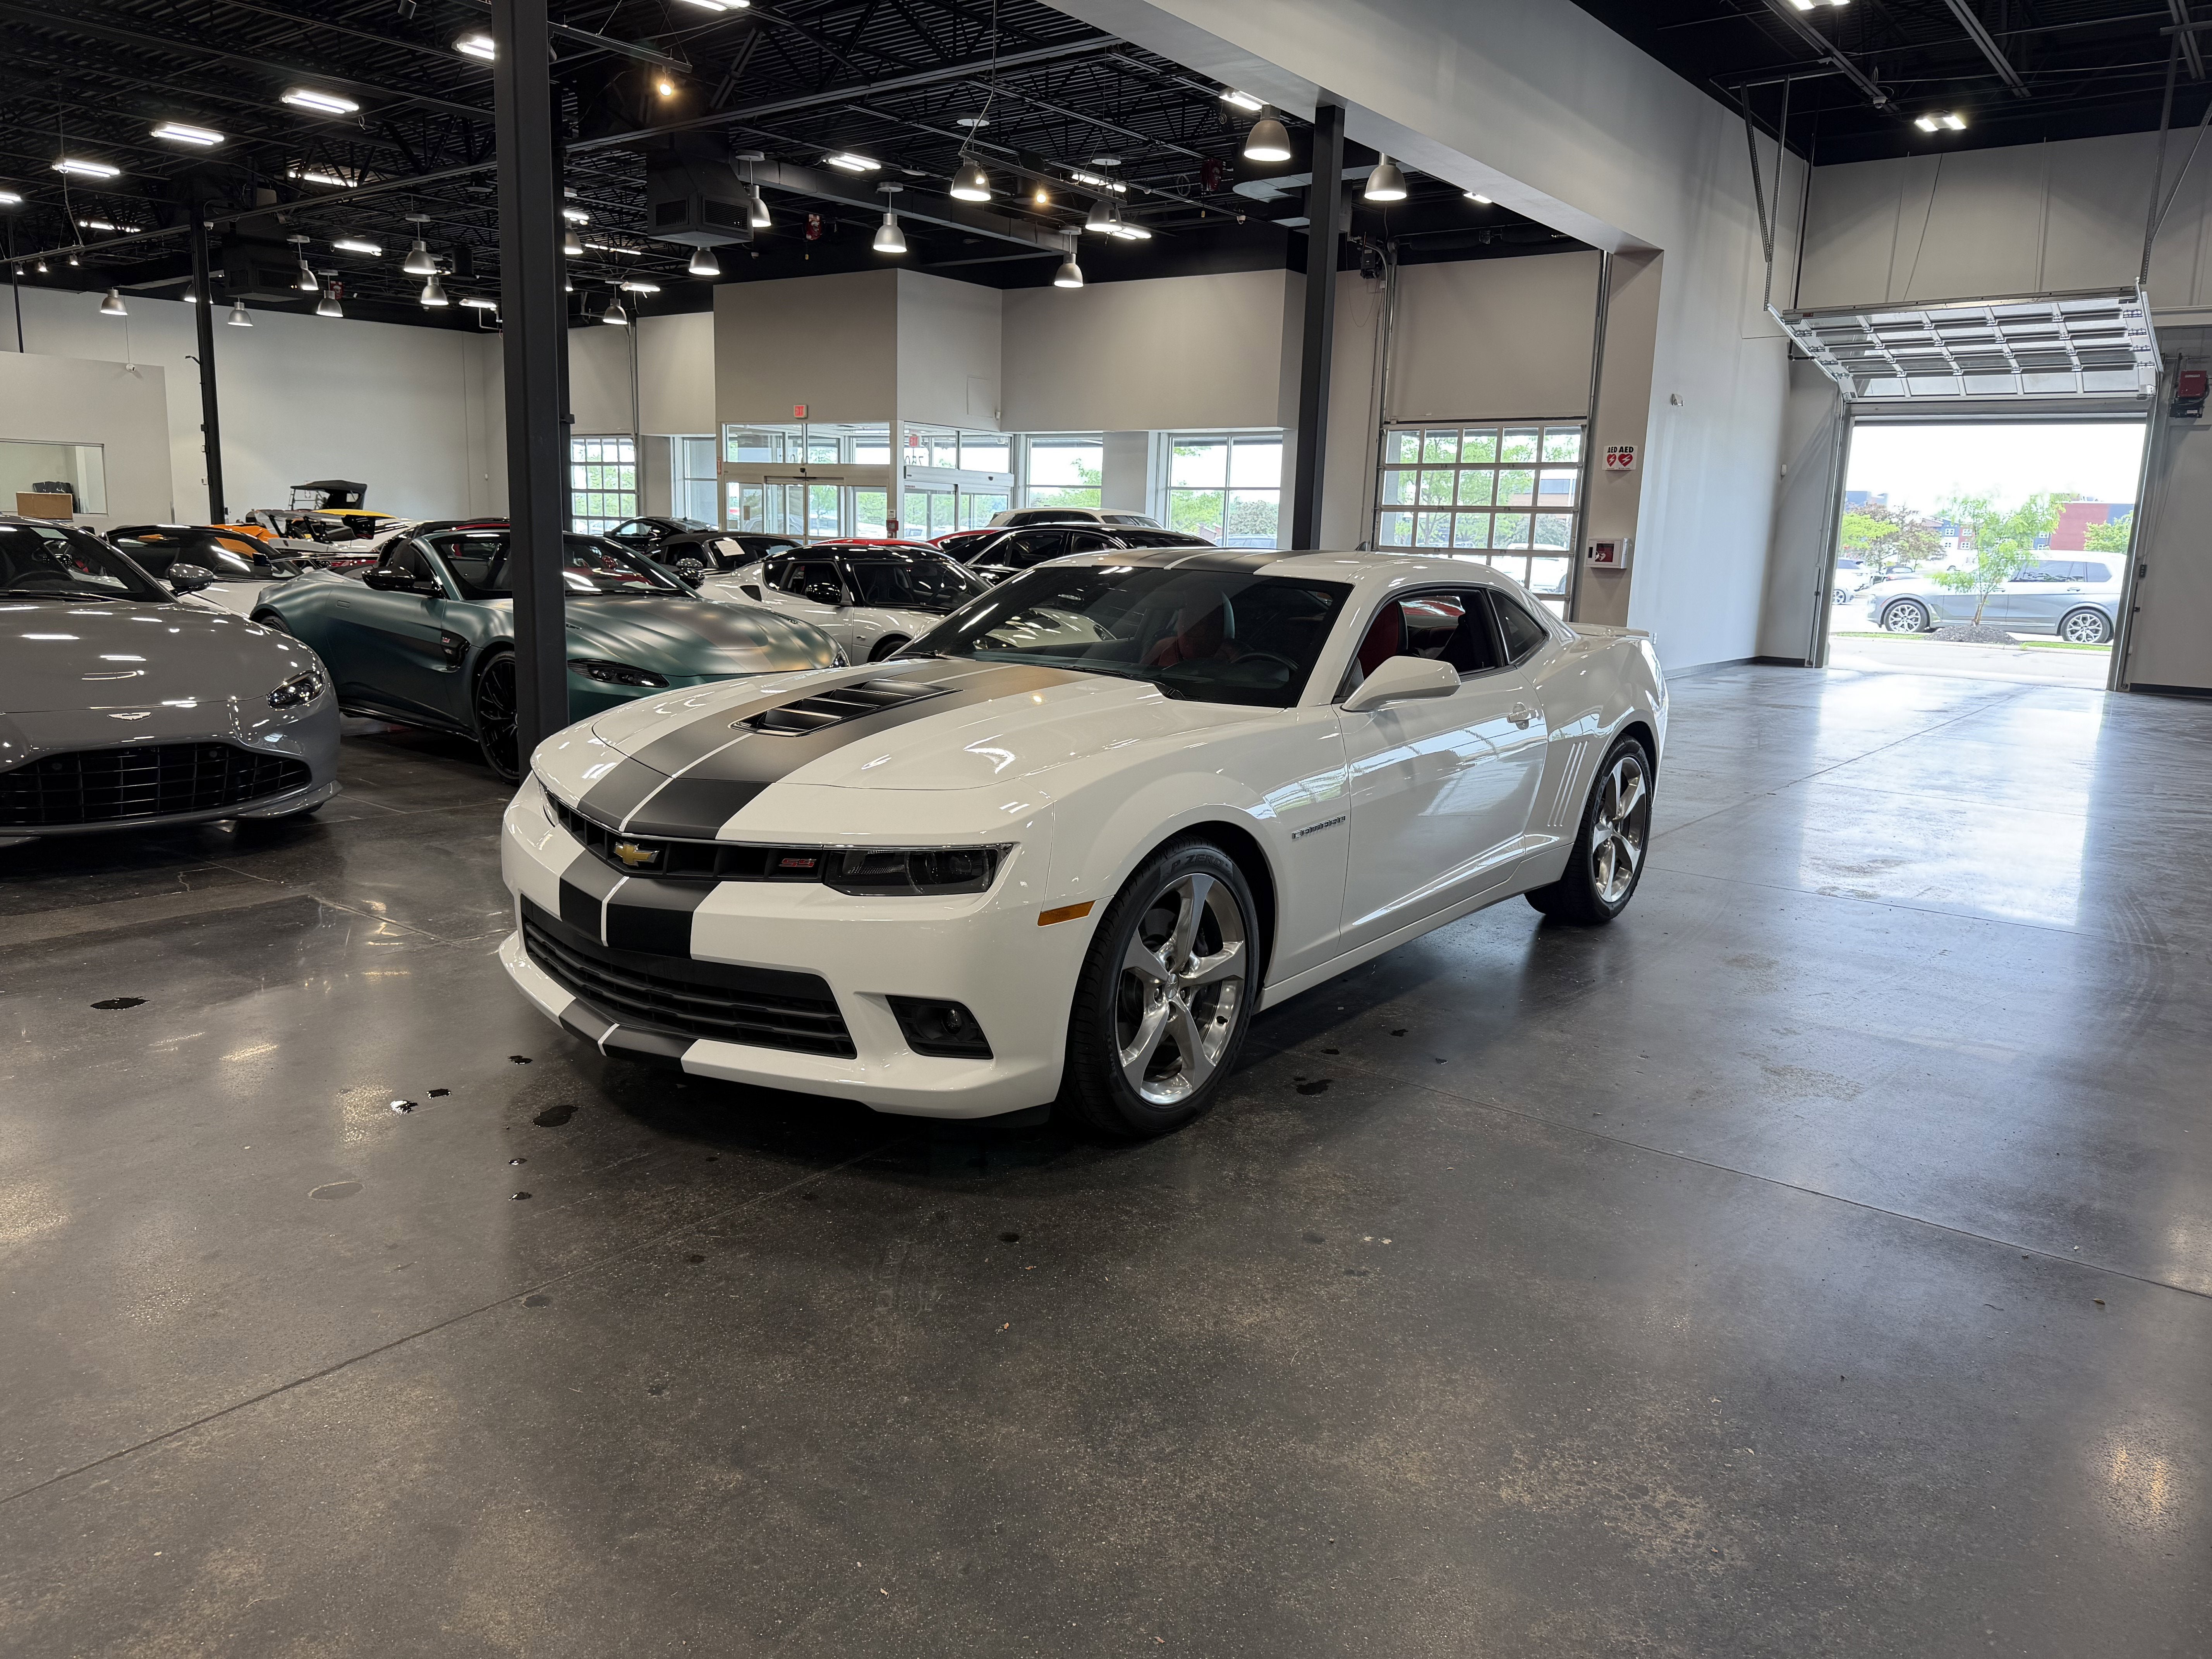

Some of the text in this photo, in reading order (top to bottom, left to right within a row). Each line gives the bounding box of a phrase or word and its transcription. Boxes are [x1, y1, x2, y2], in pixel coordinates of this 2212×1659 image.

[1292, 815, 1346, 839] CAMARO
[778, 858, 817, 867] SS
[1171, 854, 1224, 872] P ZERO
